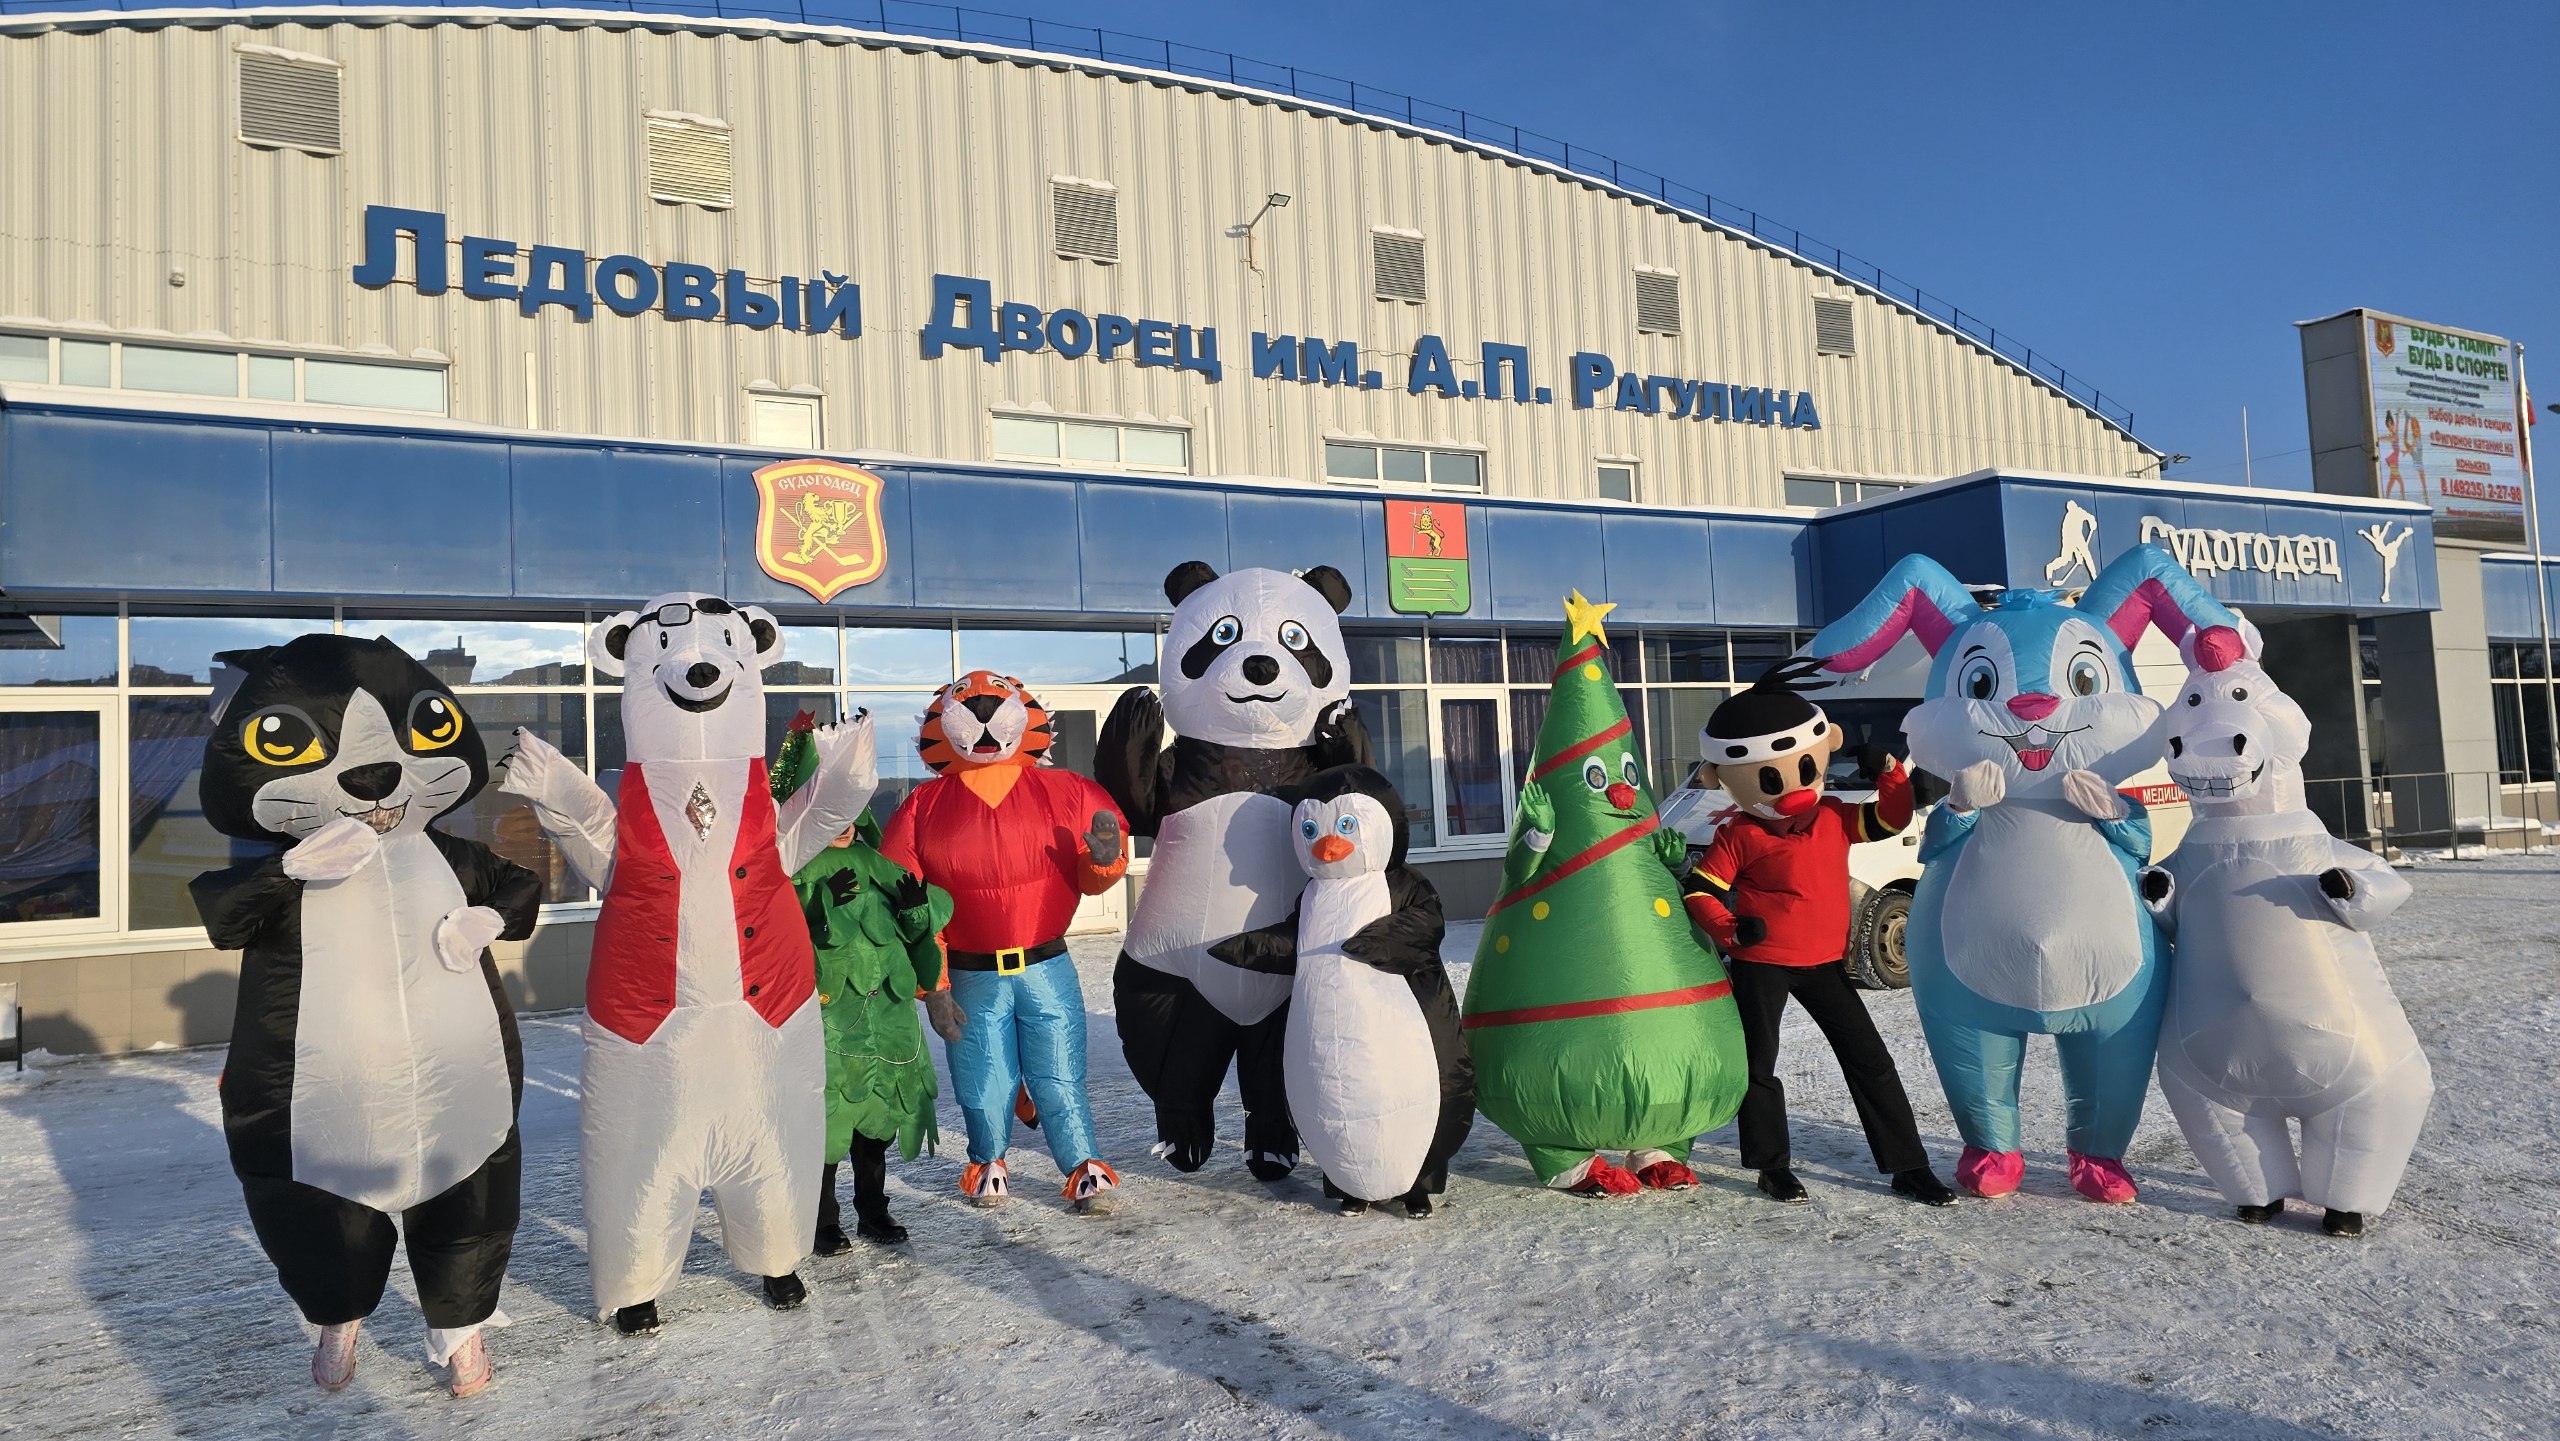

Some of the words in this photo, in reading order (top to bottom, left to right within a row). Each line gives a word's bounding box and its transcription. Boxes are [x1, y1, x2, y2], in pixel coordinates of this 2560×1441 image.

[2408, 345, 2443, 371] БУДЬ
[2445, 352, 2454, 371] В
[2456, 355, 2509, 382] СПОРТЕ!
[2440, 477, 2448, 493] 8
